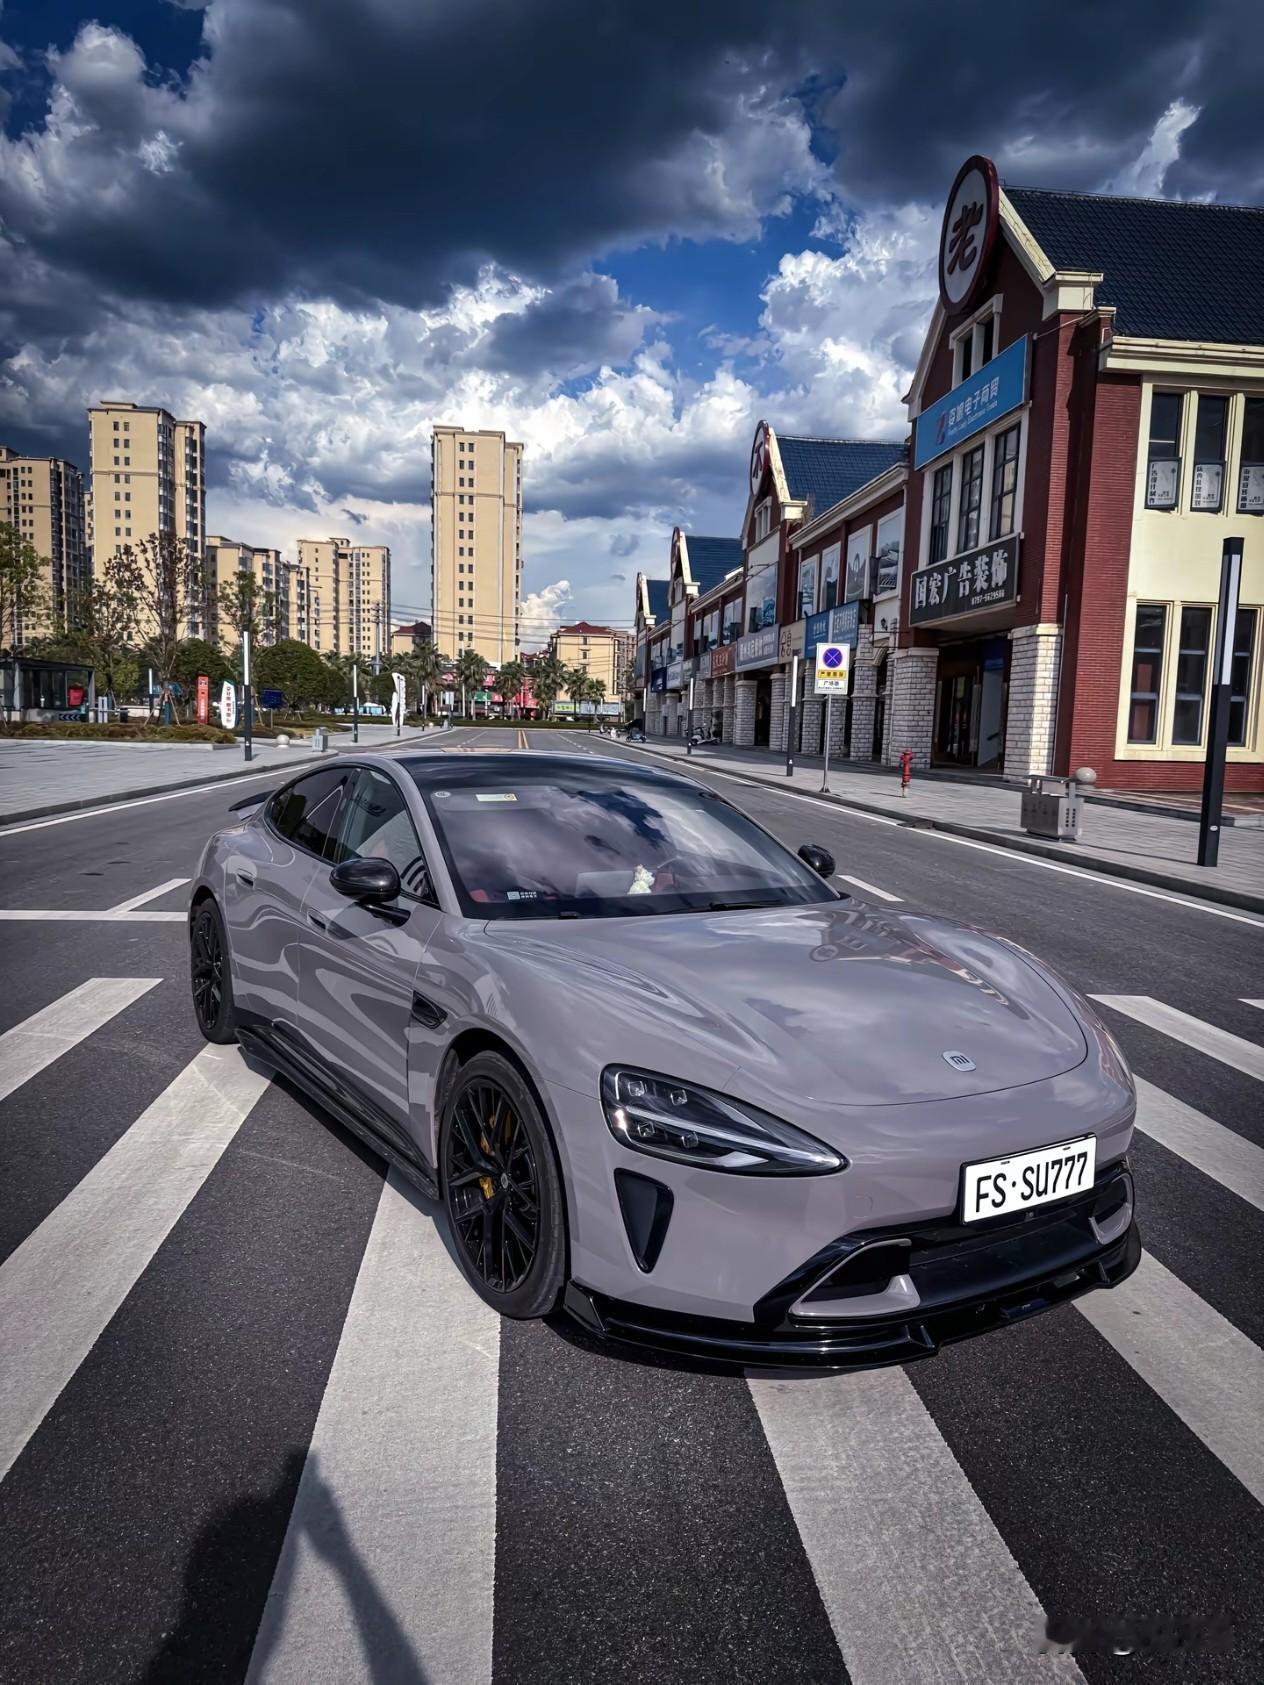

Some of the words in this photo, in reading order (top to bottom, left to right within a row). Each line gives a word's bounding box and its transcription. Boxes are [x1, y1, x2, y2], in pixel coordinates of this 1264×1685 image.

[914, 549, 1009, 609] 国宏广告装饰
